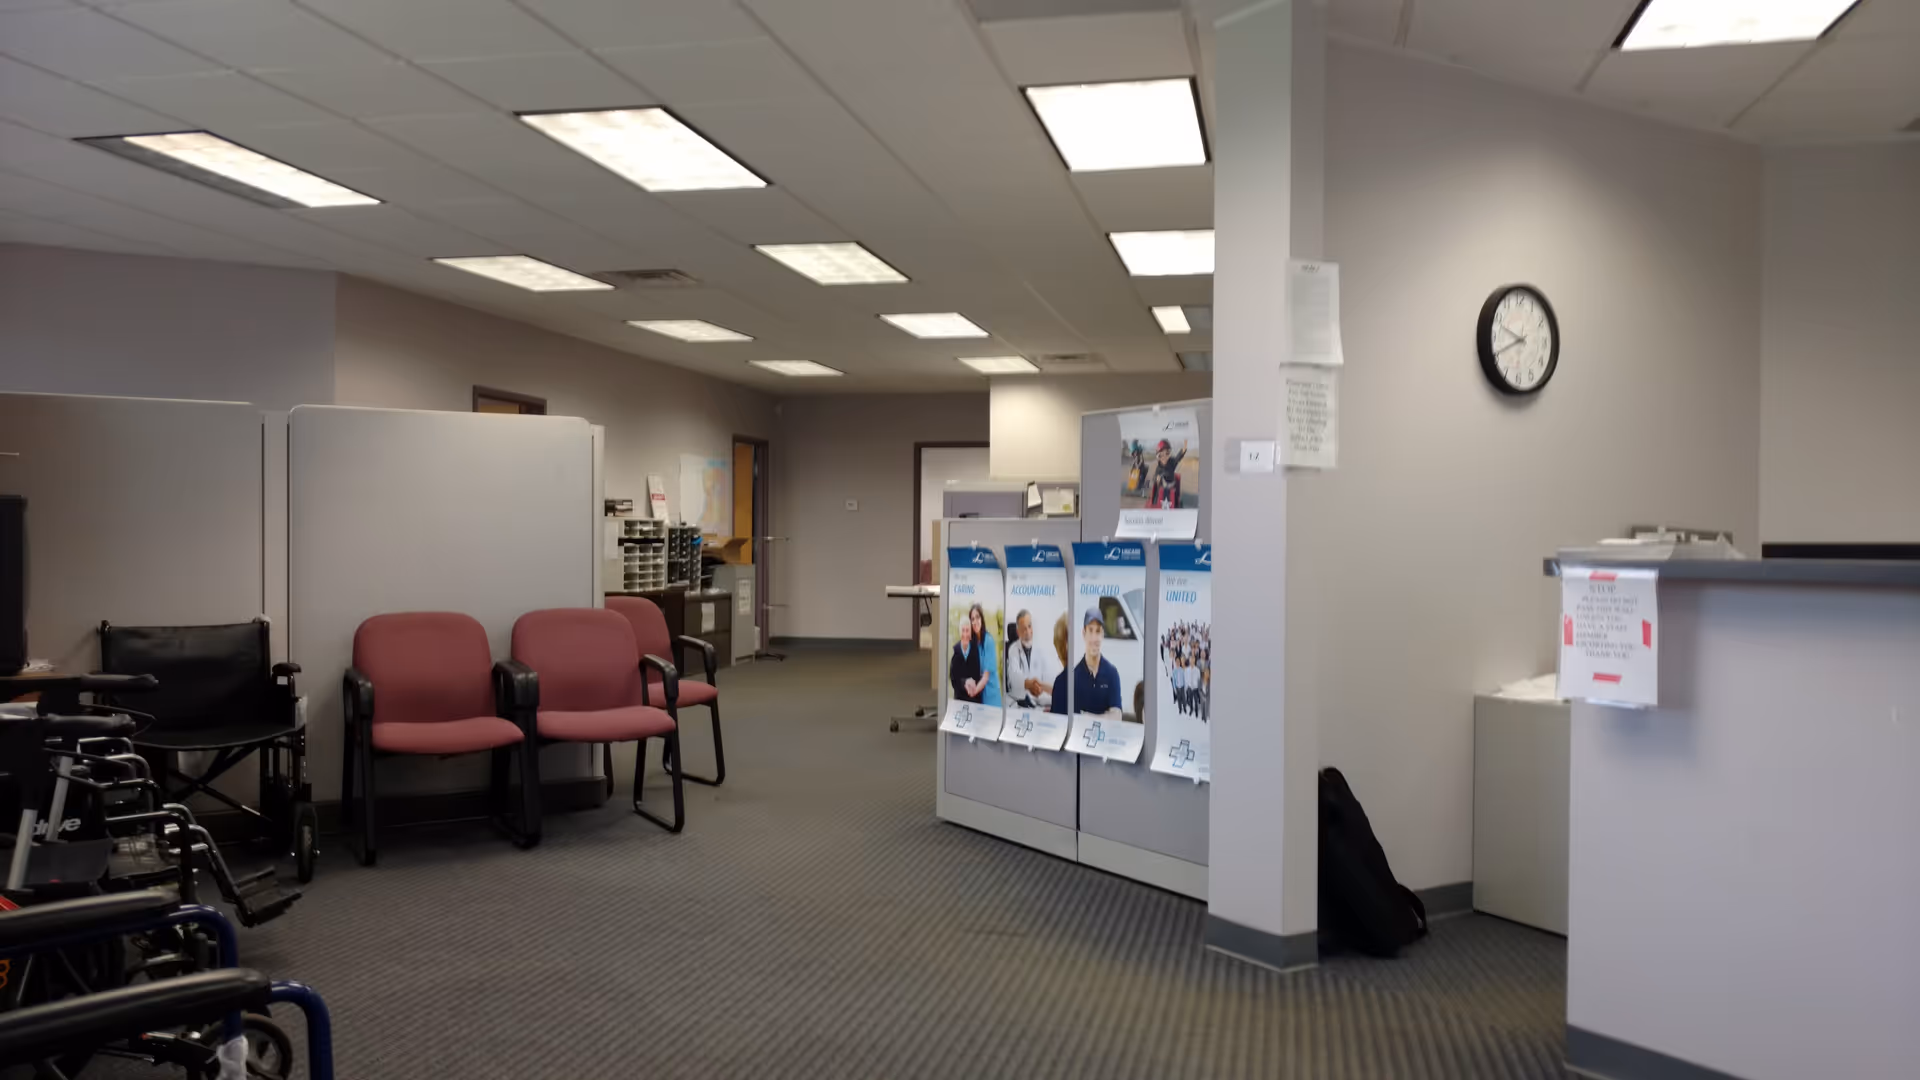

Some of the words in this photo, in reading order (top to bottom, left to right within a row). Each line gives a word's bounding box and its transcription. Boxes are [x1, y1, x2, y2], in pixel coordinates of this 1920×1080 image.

[953, 584, 976, 595] CARING
[1010, 584, 1056, 597] ACCOUNTABLE
[1080, 583, 1120, 597] DEDICATED
[1588, 583, 1617, 594] STOP
[1165, 590, 1197, 604] UNITED
[32, 818, 82, 836] drve
